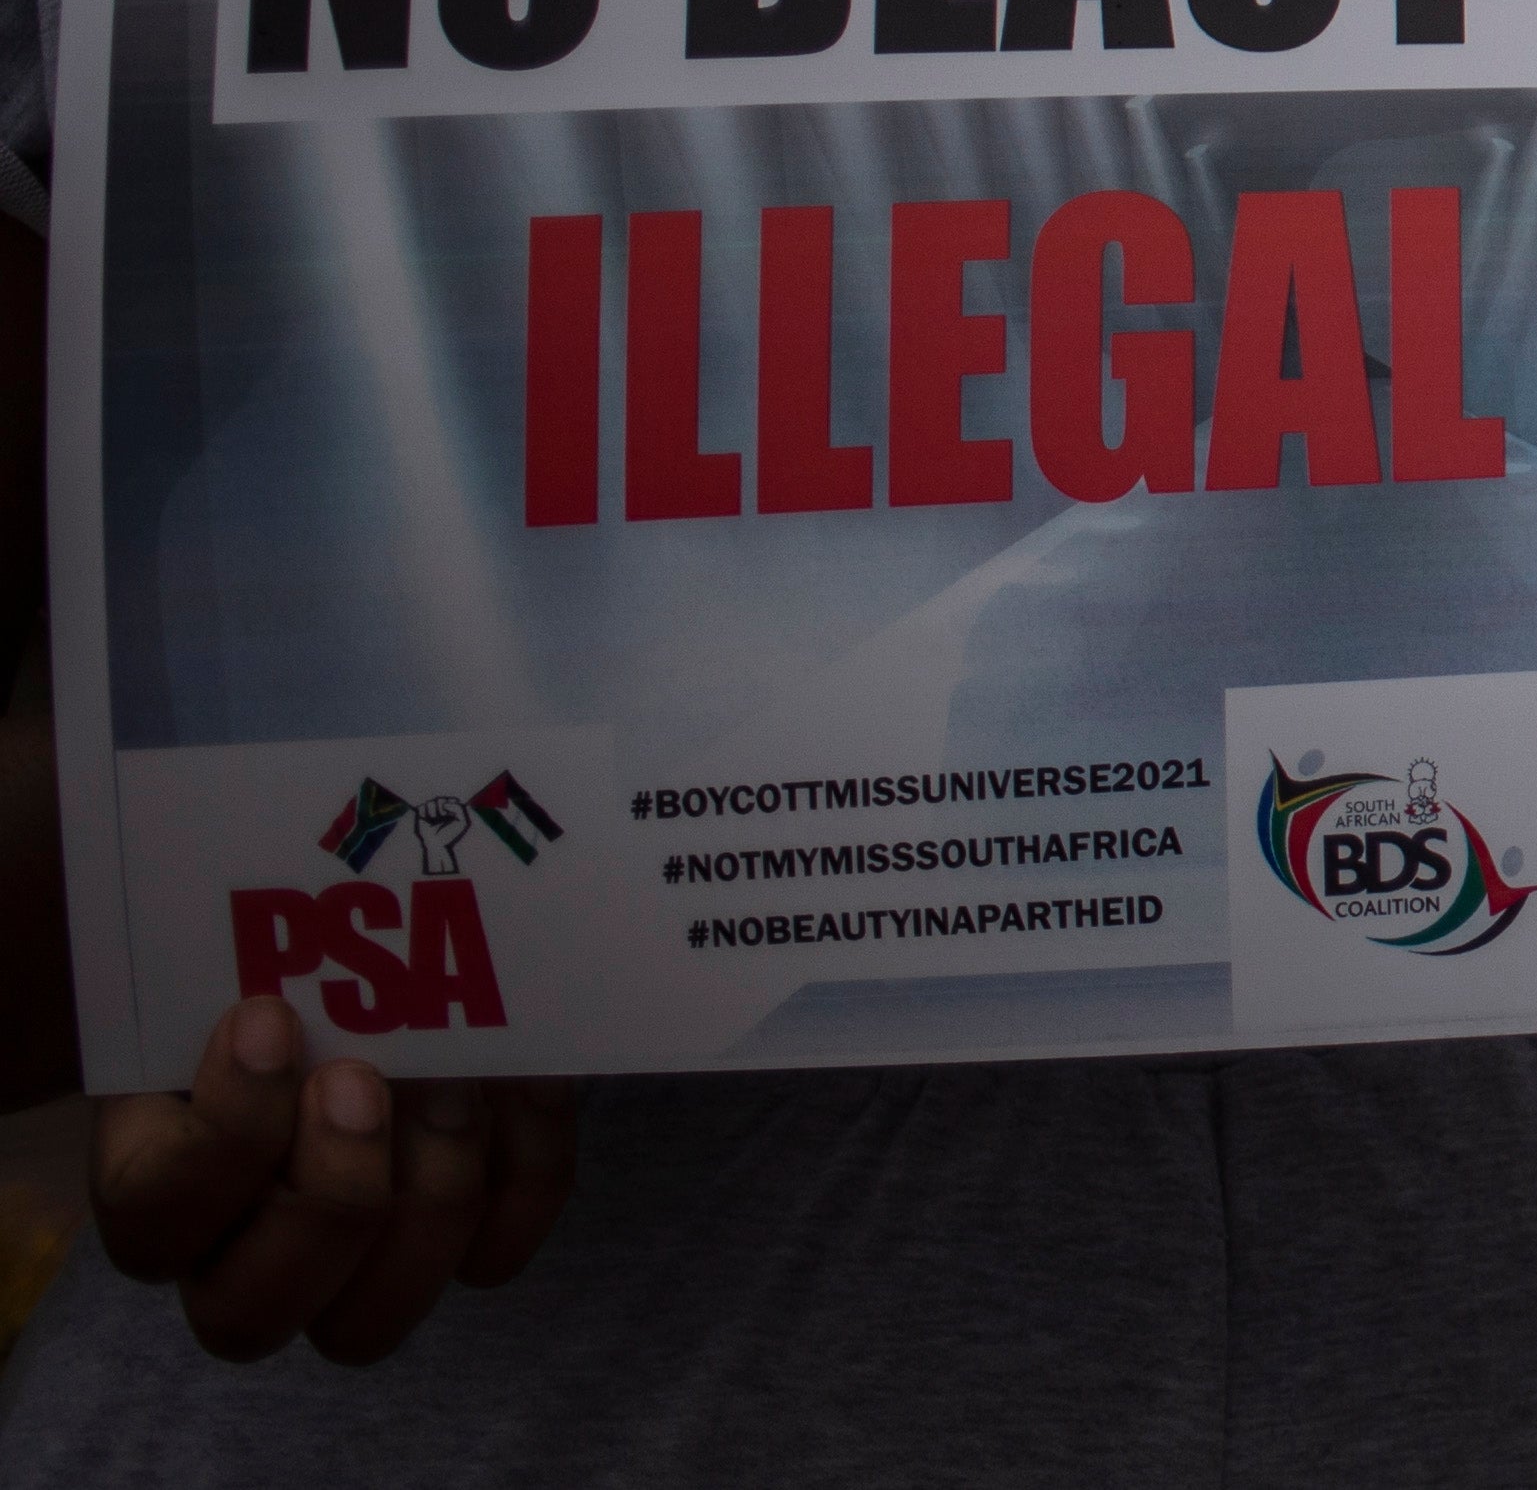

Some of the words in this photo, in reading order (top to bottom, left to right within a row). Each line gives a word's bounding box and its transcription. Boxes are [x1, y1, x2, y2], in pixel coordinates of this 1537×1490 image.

[526, 187, 1505, 526] ILLEGAL
[631, 758, 1210, 820] #BOYCOTTMISSUNIVERSE2021
[1345, 800, 1395, 814] SOUTH
[1336, 813, 1400, 828] AFRICAN
[663, 827, 1182, 884] #NOTMYMISSSOUTHAFRICA
[1324, 828, 1451, 896] BDS
[687, 896, 1162, 948] #NOBEAUTYINAPARTHEID
[1335, 897, 1440, 918] COALITION
[230, 879, 507, 1034] PSA
